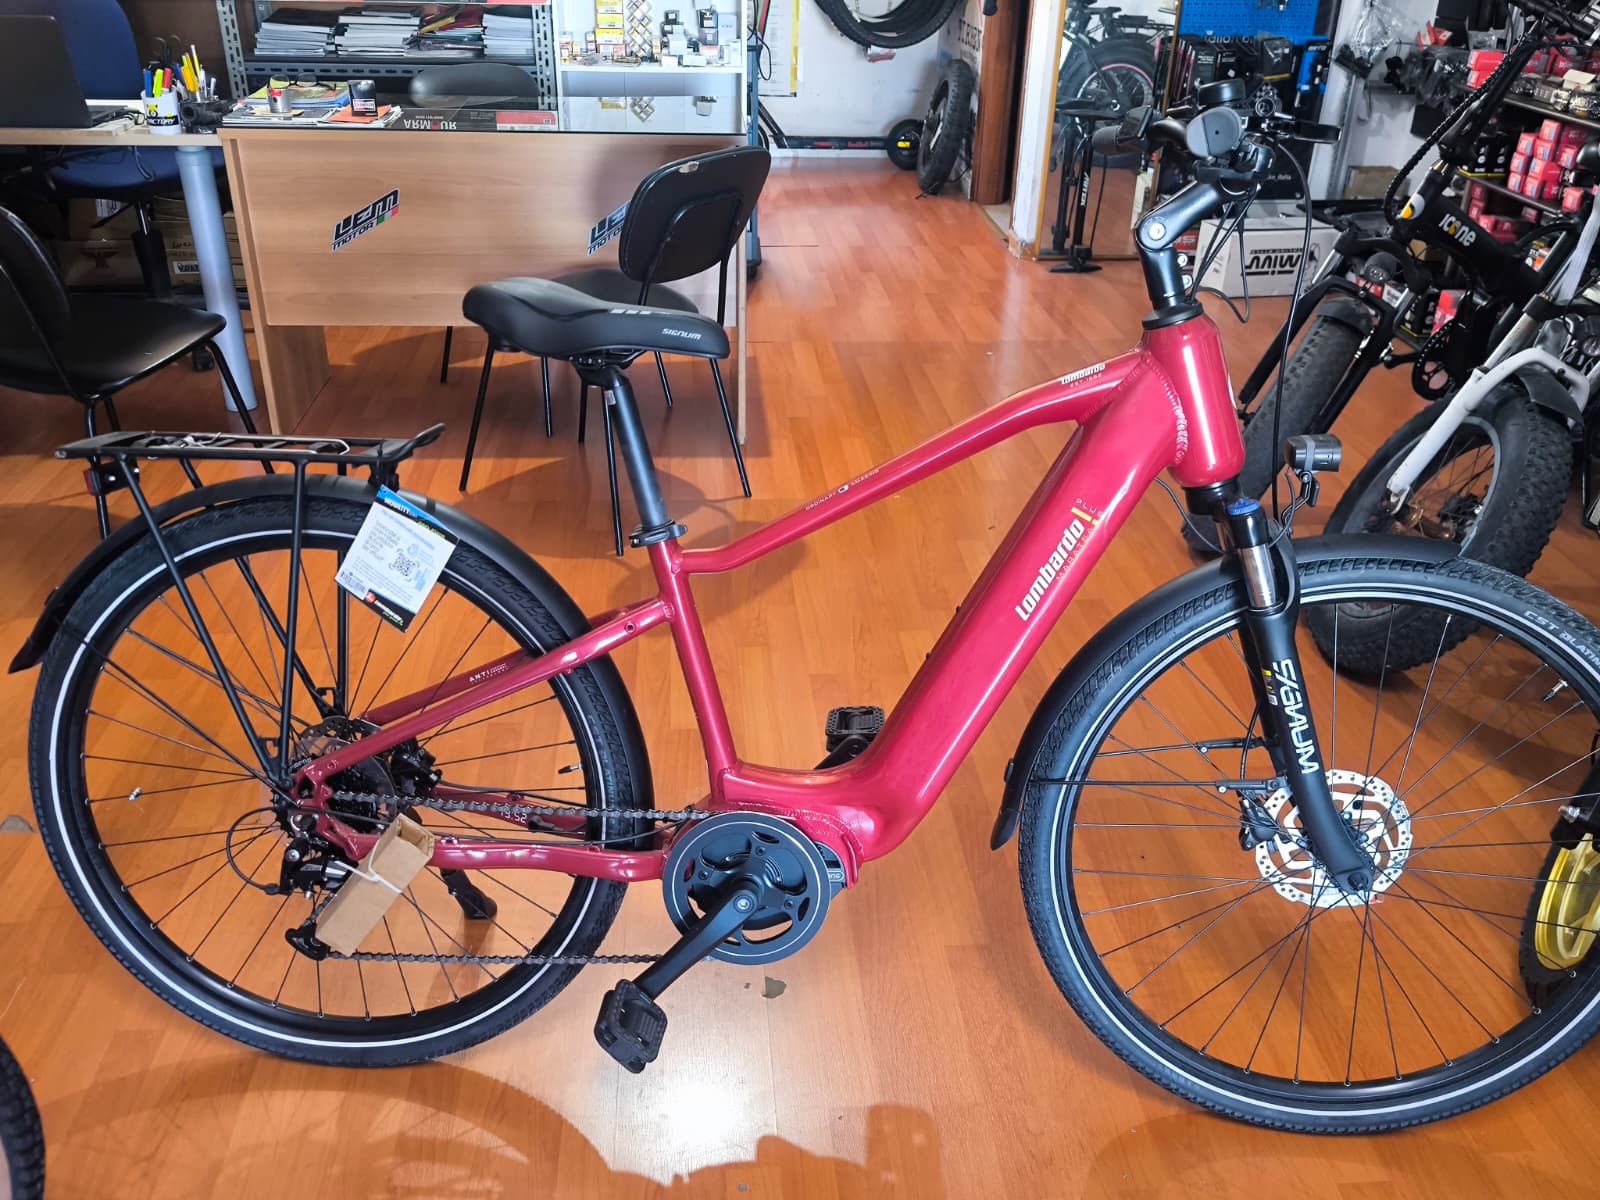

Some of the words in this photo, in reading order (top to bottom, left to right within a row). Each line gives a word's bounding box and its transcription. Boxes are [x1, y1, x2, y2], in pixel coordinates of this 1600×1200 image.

[590, 203, 631, 245] LE
[661, 327, 702, 341] SIGNUM
[1014, 518, 1085, 622] Lombardo
[1272, 658, 1320, 775] SIGNUM
